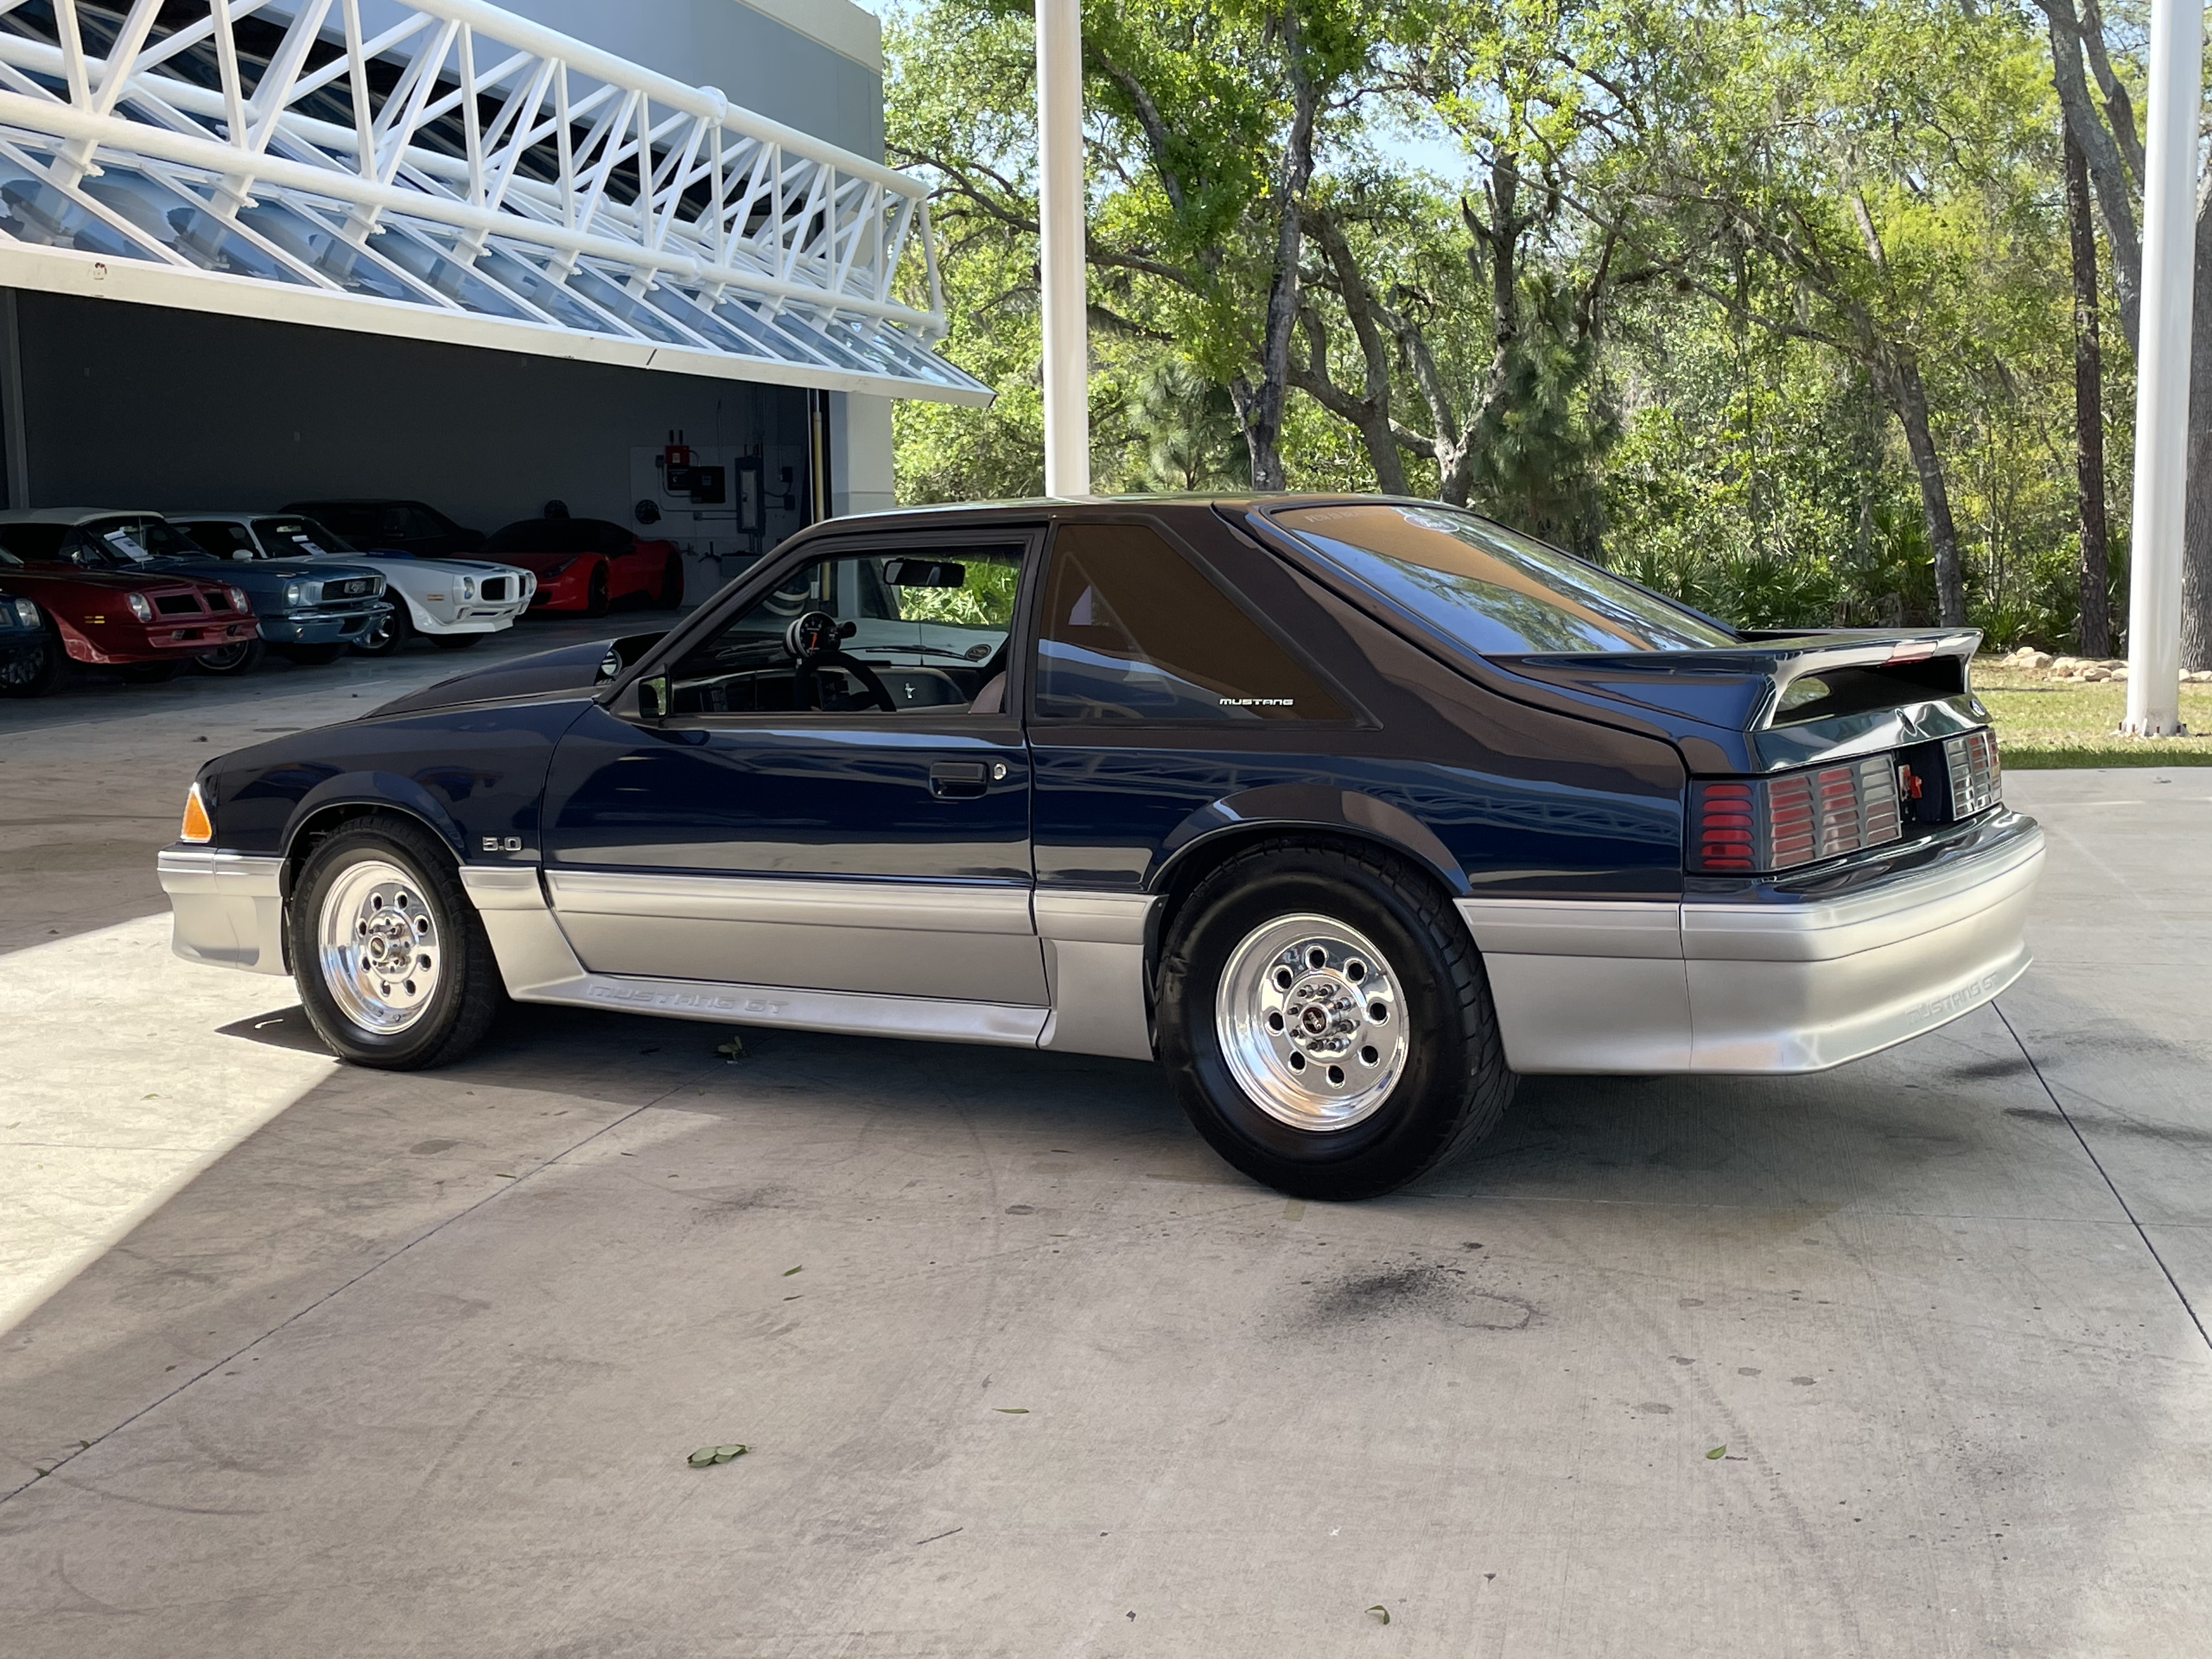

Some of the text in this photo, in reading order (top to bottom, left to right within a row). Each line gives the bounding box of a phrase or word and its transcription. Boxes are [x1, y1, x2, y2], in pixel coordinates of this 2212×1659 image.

[482, 836, 522, 851] 5.0
[588, 983, 789, 1014] MUSTANG GT
[1905, 982, 1981, 1025] MUSTANG
